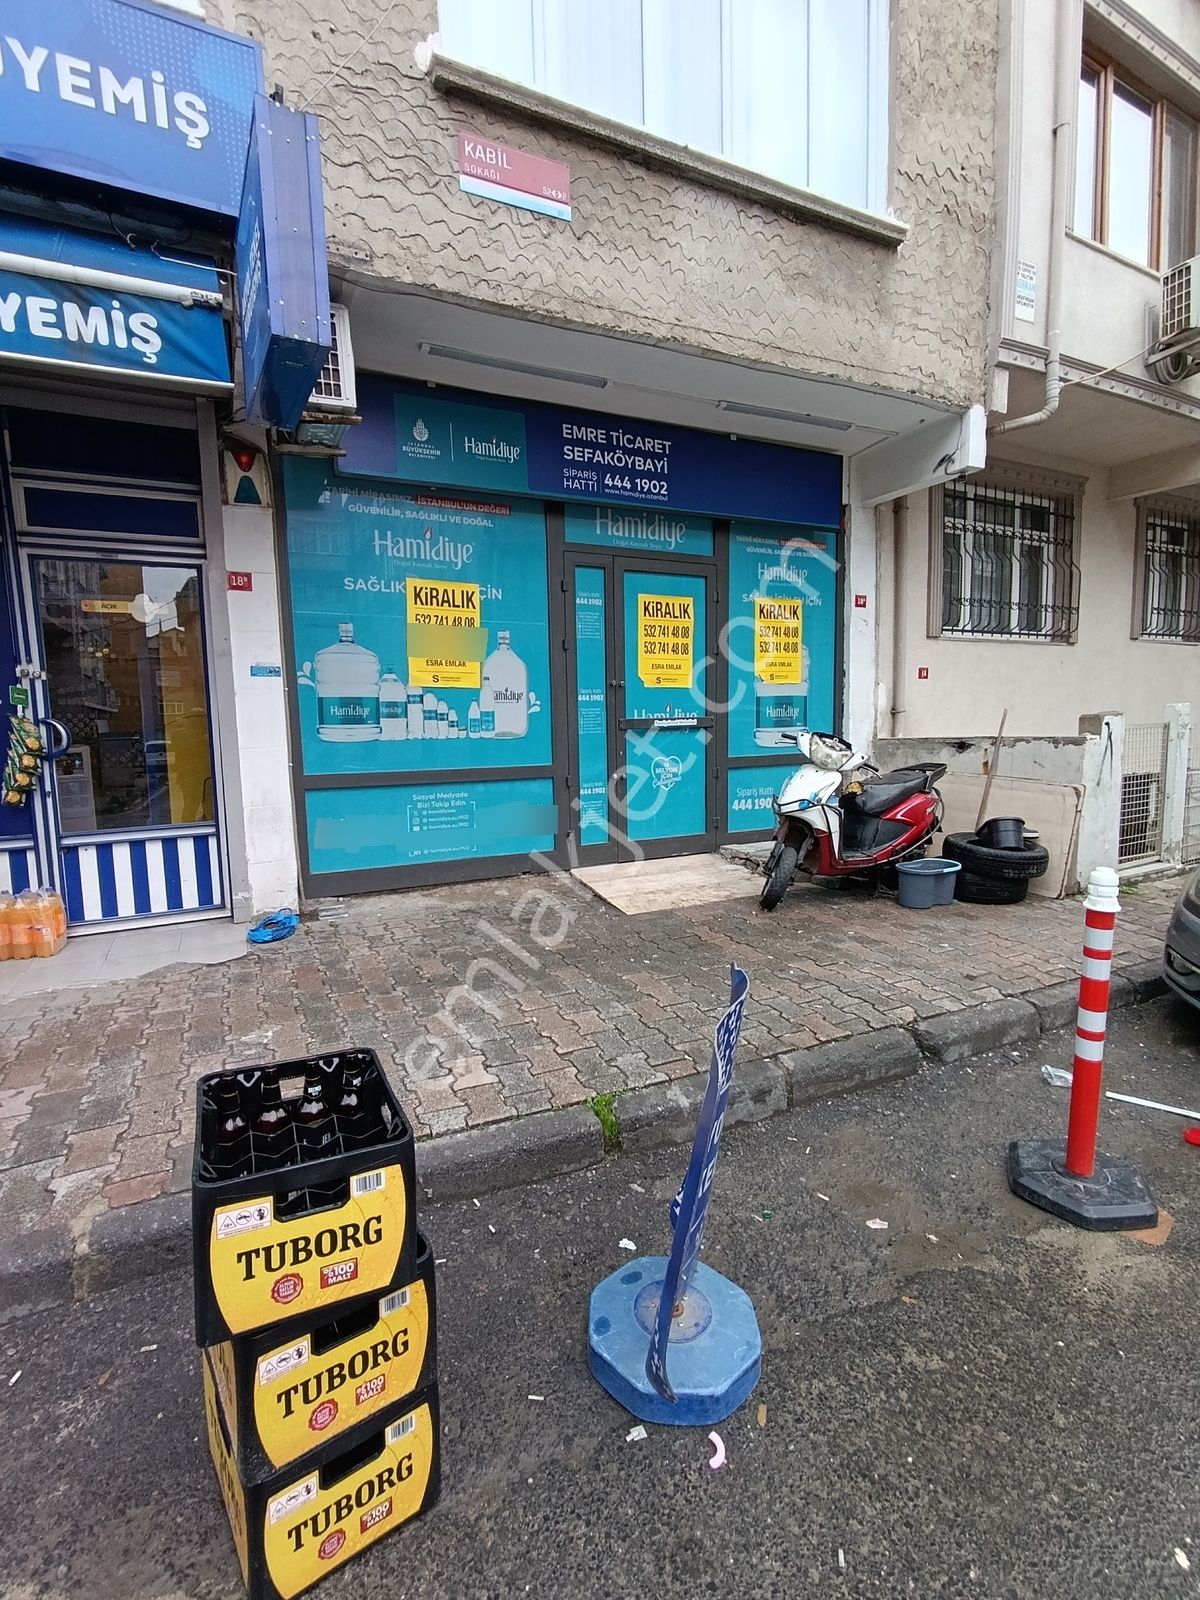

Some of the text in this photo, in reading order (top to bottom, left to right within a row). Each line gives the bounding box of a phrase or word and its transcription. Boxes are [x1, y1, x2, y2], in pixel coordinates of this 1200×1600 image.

[0, 36, 210, 149] YEMİŞ
[464, 140, 512, 170] KABİL
[463, 162, 500, 181] SOKAĞI
[562, 423, 672, 454] EMRE TİCARET
[464, 436, 521, 464] Hamidiye
[563, 445, 668, 474] SEFAKÖYBAYİ
[563, 467, 598, 481] SİPARİŞ
[563, 477, 597, 492] HATTI
[604, 473, 669, 495] 444 1902
[604, 487, 669, 501] www.hamidiye.istanbul
[417, 495, 477, 511] İSTANBUL'UN
[478, 503, 511, 515] DEĞERİ
[349, 503, 495, 527] GÜVENİLİR, SAĞLIKLI VE DOĞAL
[594, 507, 687, 549] Hamidiye
[373, 527, 474, 570] Hamidiye
[758, 563, 808, 586] Hamidiye
[344, 576, 502, 601] SAĞLIK ÇİN
[805, 595, 822, 607] İÇİN
[644, 625, 689, 639] 532 741 48 08
[760, 625, 799, 638] 532 741 48 08
[644, 641, 689, 655] 532 741 48 08
[760, 641, 798, 653] 532 741 48 08
[426, 659, 467, 668] ESRA EMLAK
[432, 675, 439, 683] S
[656, 676, 661, 684] S
[493, 687, 524, 704] amidiye
[330, 704, 370, 719] Hamidiye
[766, 704, 800, 720] Hamidiye
[412, 791, 469, 801] Sosyal Medyada
[736, 787, 758, 798] Sipariş
[432, 800, 450, 808] Takip
[451, 799, 466, 807] Edin
[732, 797, 772, 810] 444 190
[236, 1215, 382, 1281] TUBORG
[322, 1263, 355, 1281] %100
[327, 1272, 352, 1285] MALT
[276, 1328, 410, 1419] TUBORG
[359, 1386, 383, 1403] MALT
[287, 1453, 413, 1553] TUBORG
[366, 1510, 388, 1528] MALT
